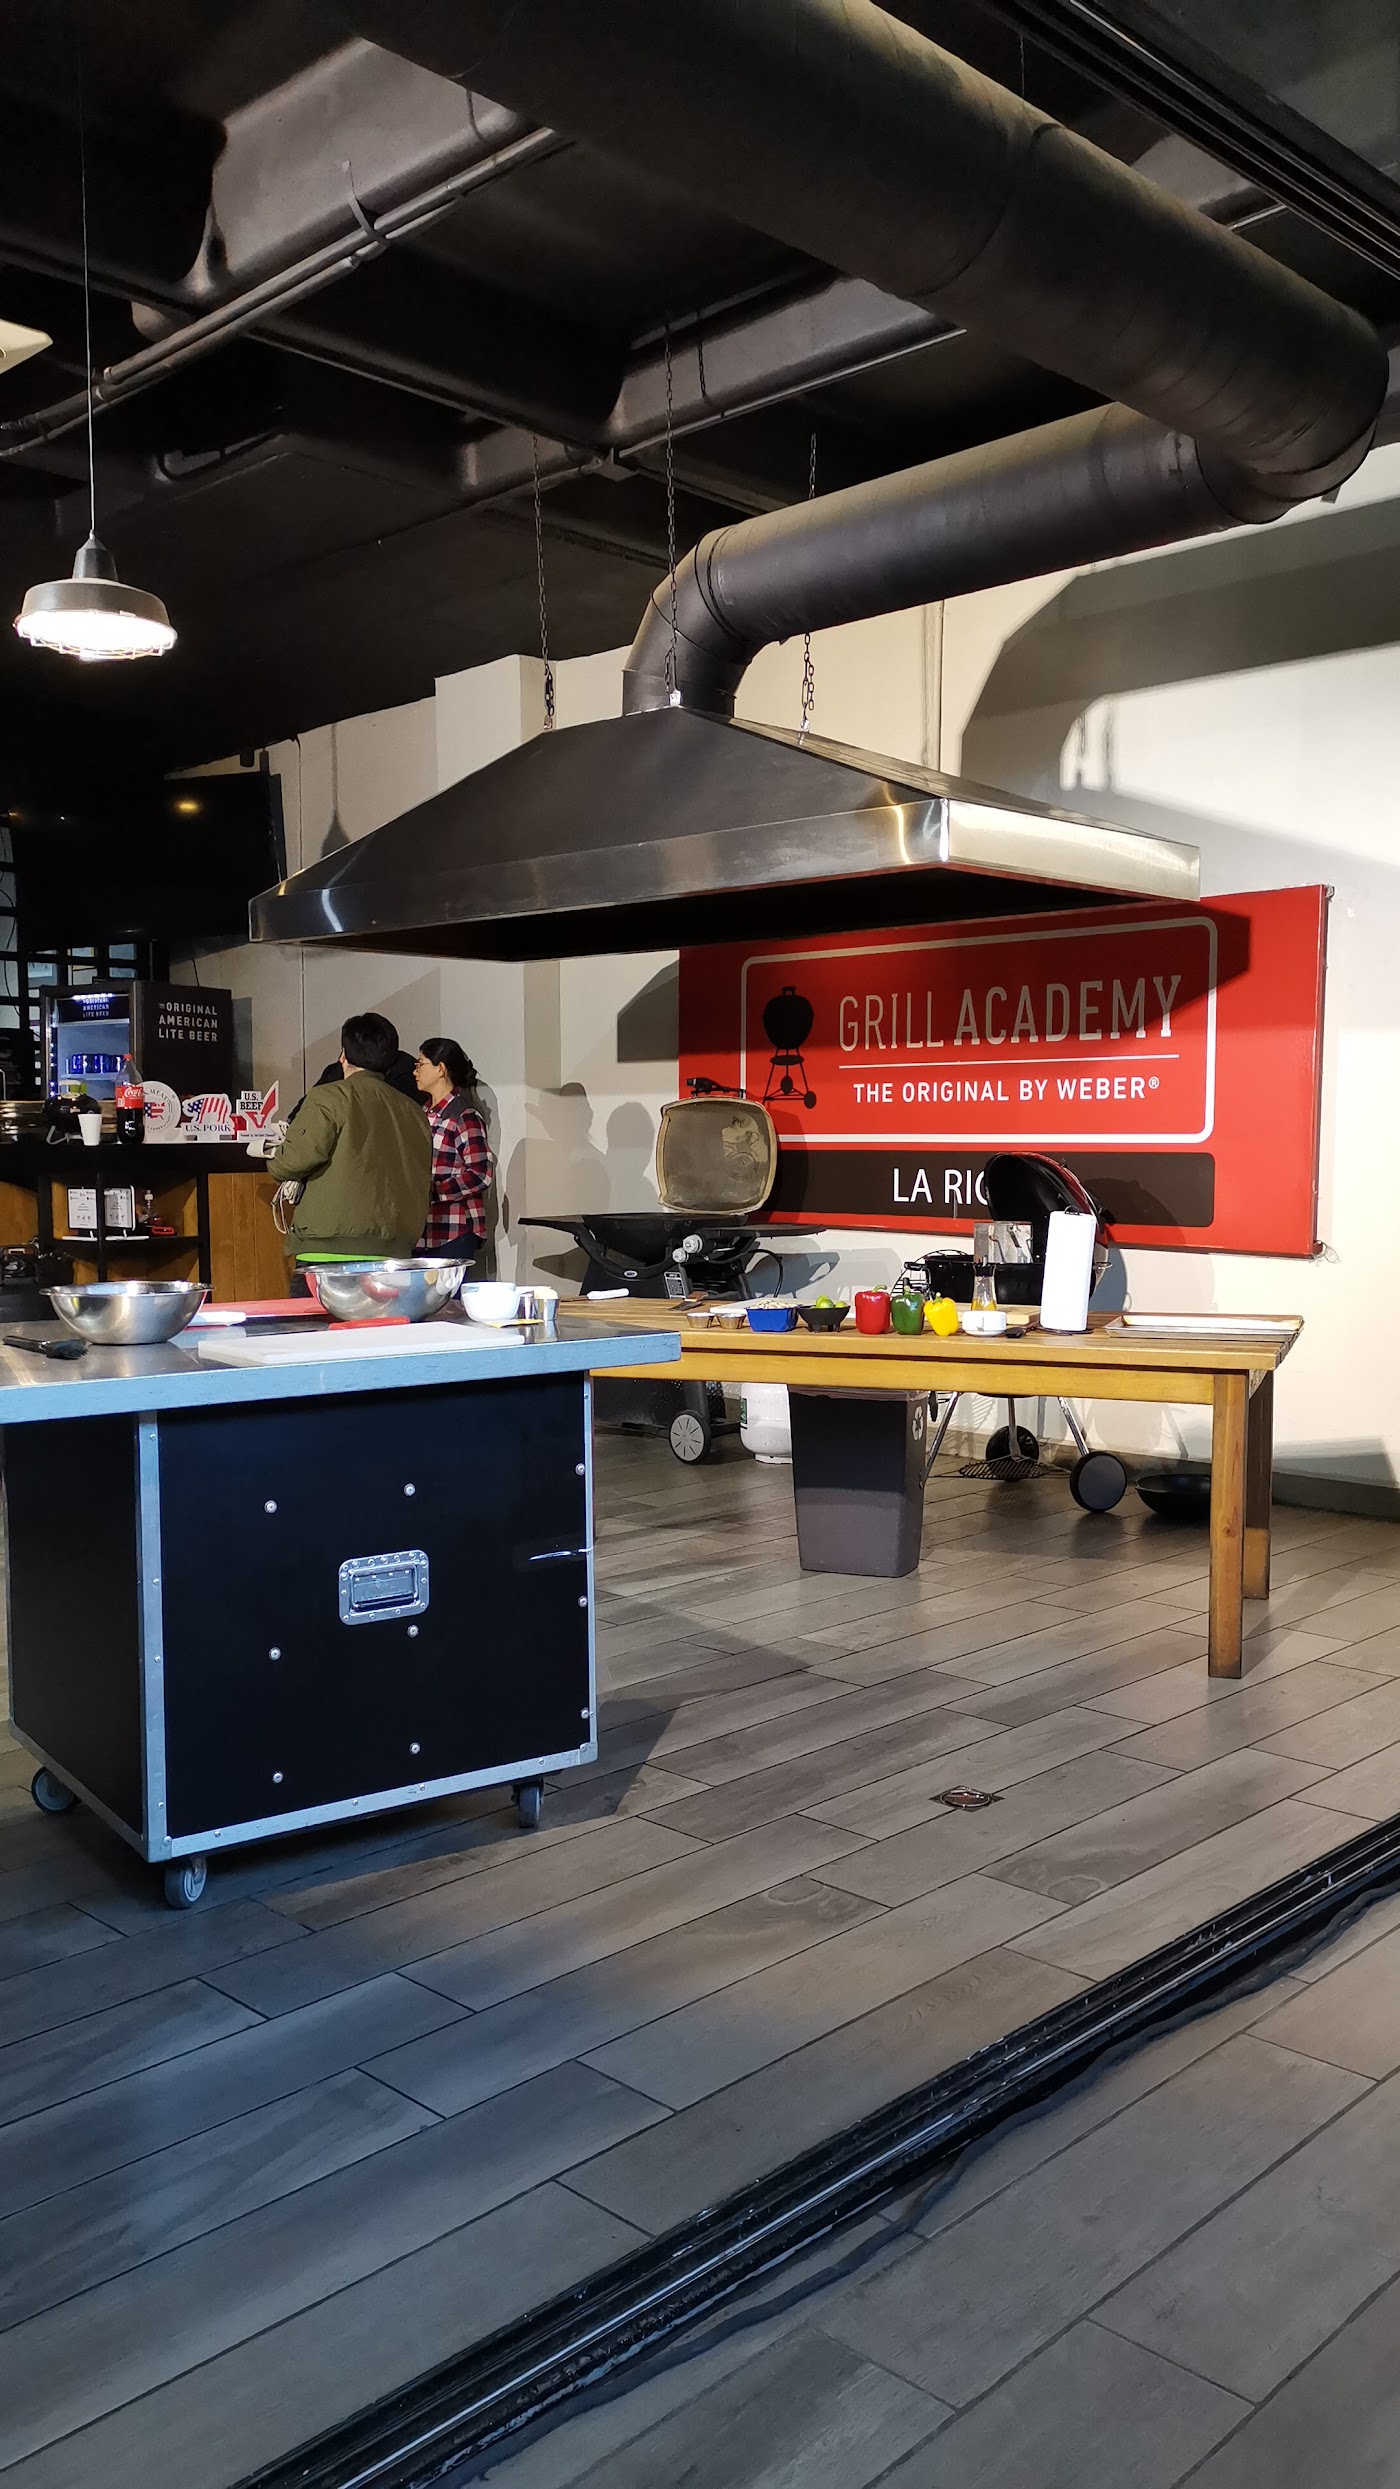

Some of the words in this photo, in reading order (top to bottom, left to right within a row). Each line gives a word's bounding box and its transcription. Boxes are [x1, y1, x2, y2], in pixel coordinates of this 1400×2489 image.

[166, 1002, 218, 1016] ORIGINAL
[839, 990, 944, 1051] GRILL
[954, 975, 1181, 1045] ACADEMY
[158, 1014, 218, 1029] AMERICAN
[158, 1028, 184, 1040] LITE
[189, 1030, 218, 1042] BEER
[244, 1092, 259, 1101] U.S.
[853, 1083, 893, 1103] THE
[902, 1081, 1009, 1102] ORIGINAL
[1019, 1079, 1048, 1101] BY
[240, 1101, 263, 1111] BEEF
[203, 1123, 232, 1132] PORK
[893, 1168, 933, 1203] LA
